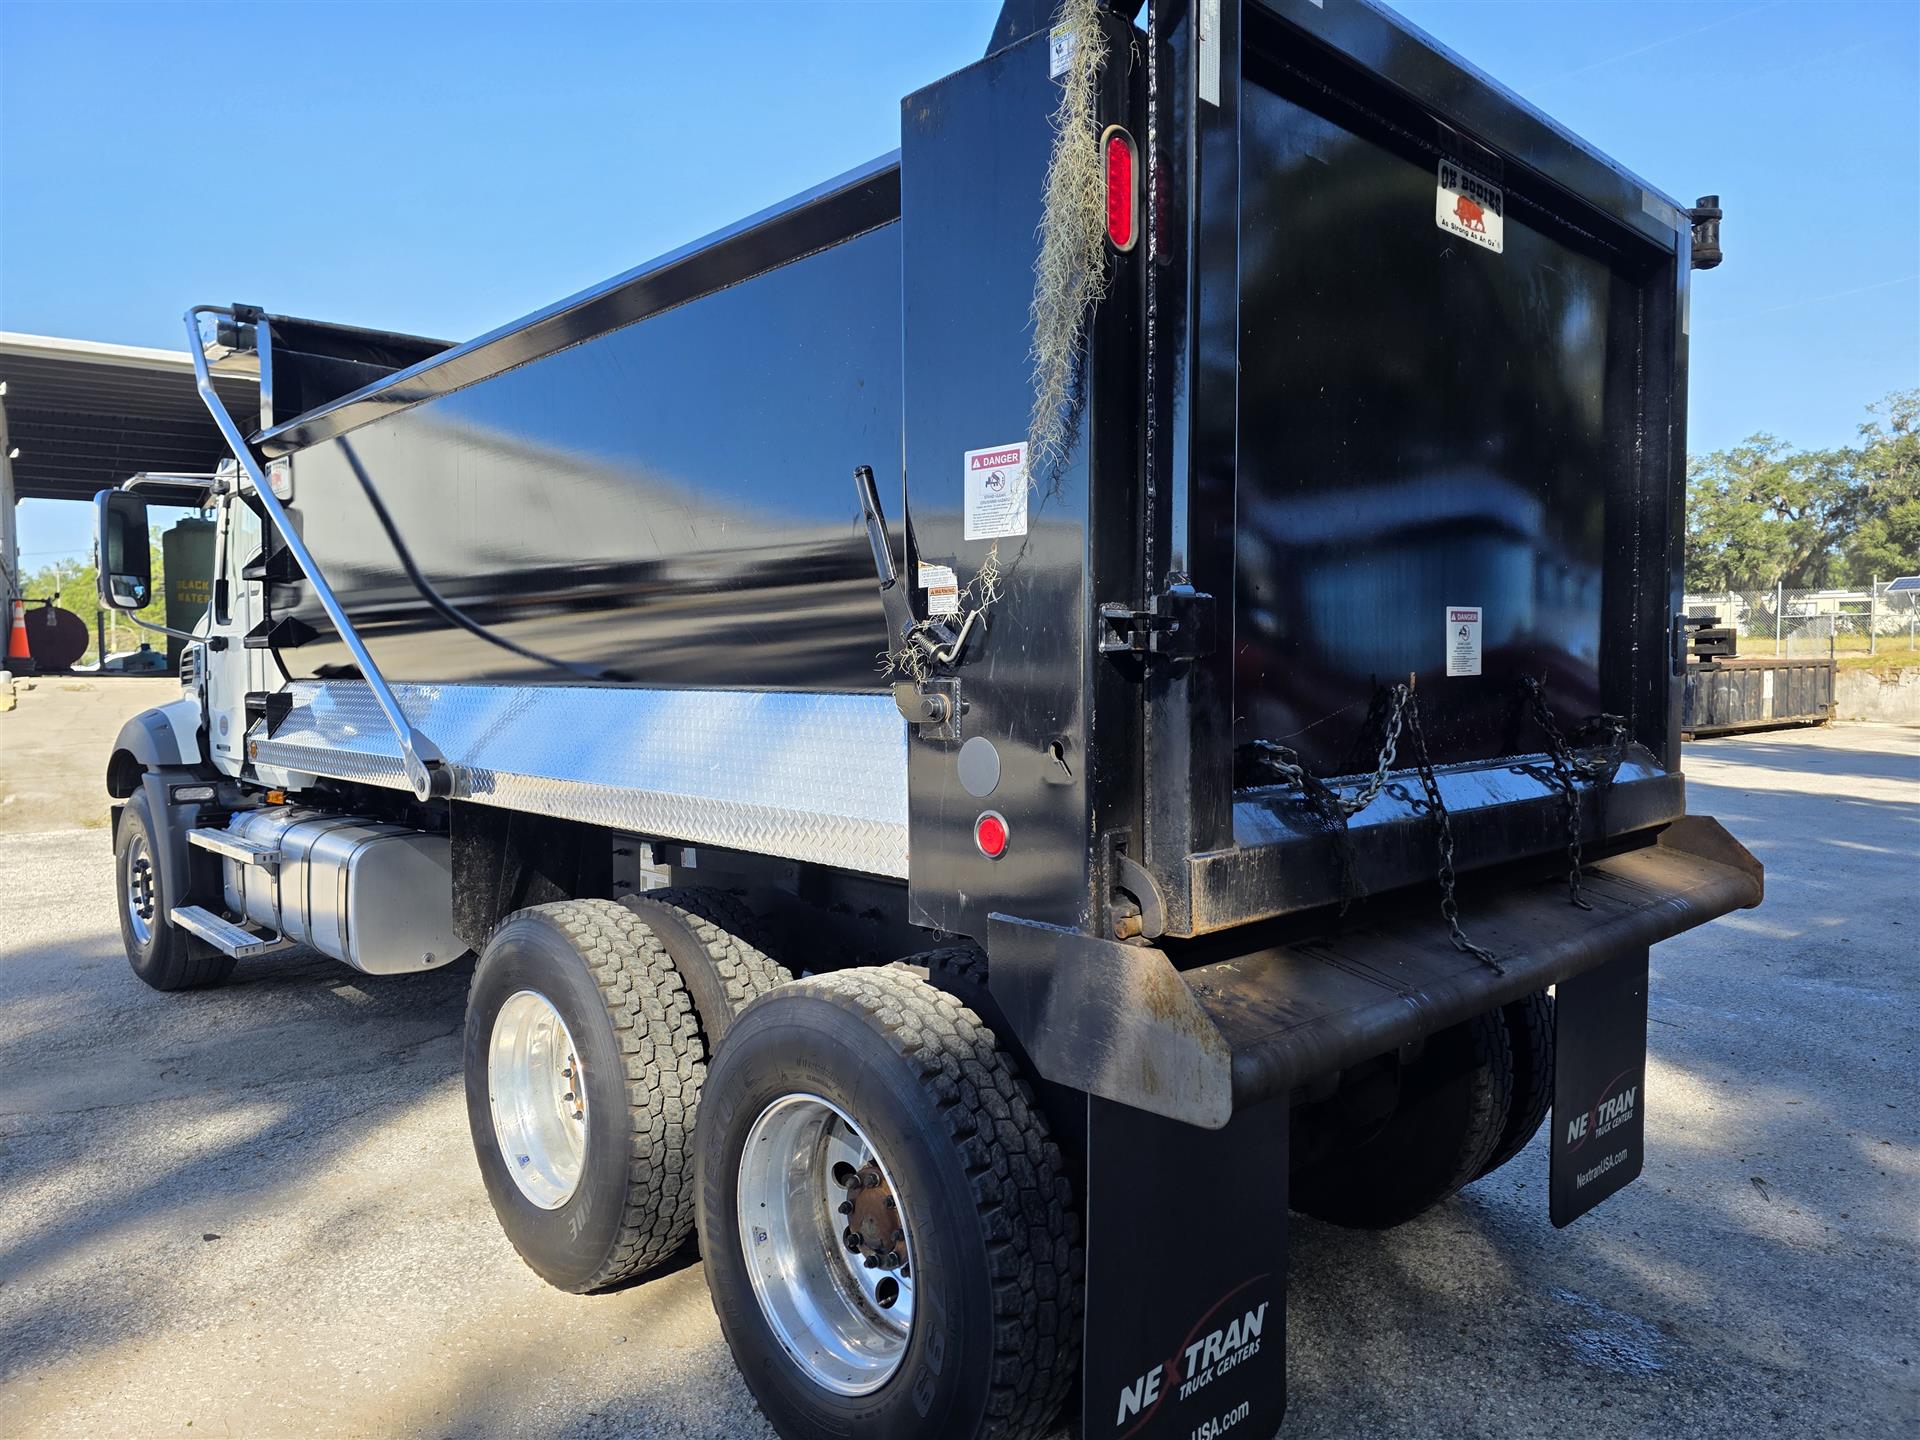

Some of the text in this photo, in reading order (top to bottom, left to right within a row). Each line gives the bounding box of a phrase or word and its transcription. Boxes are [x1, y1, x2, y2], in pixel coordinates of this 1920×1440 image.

[1441, 165, 1502, 217] OX BODIES
[1451, 222, 1470, 237] Strong
[983, 453, 1019, 467] DANGER
[1566, 1087, 1637, 1145] NEXTRAN
[1595, 1110, 1634, 1139] TRUCK CENTERS
[1576, 1148, 1628, 1190] NextranUSA.com
[1116, 1302, 1267, 1427] NEXTRAN
[1179, 1338, 1261, 1401] TRUCK CENTERS
